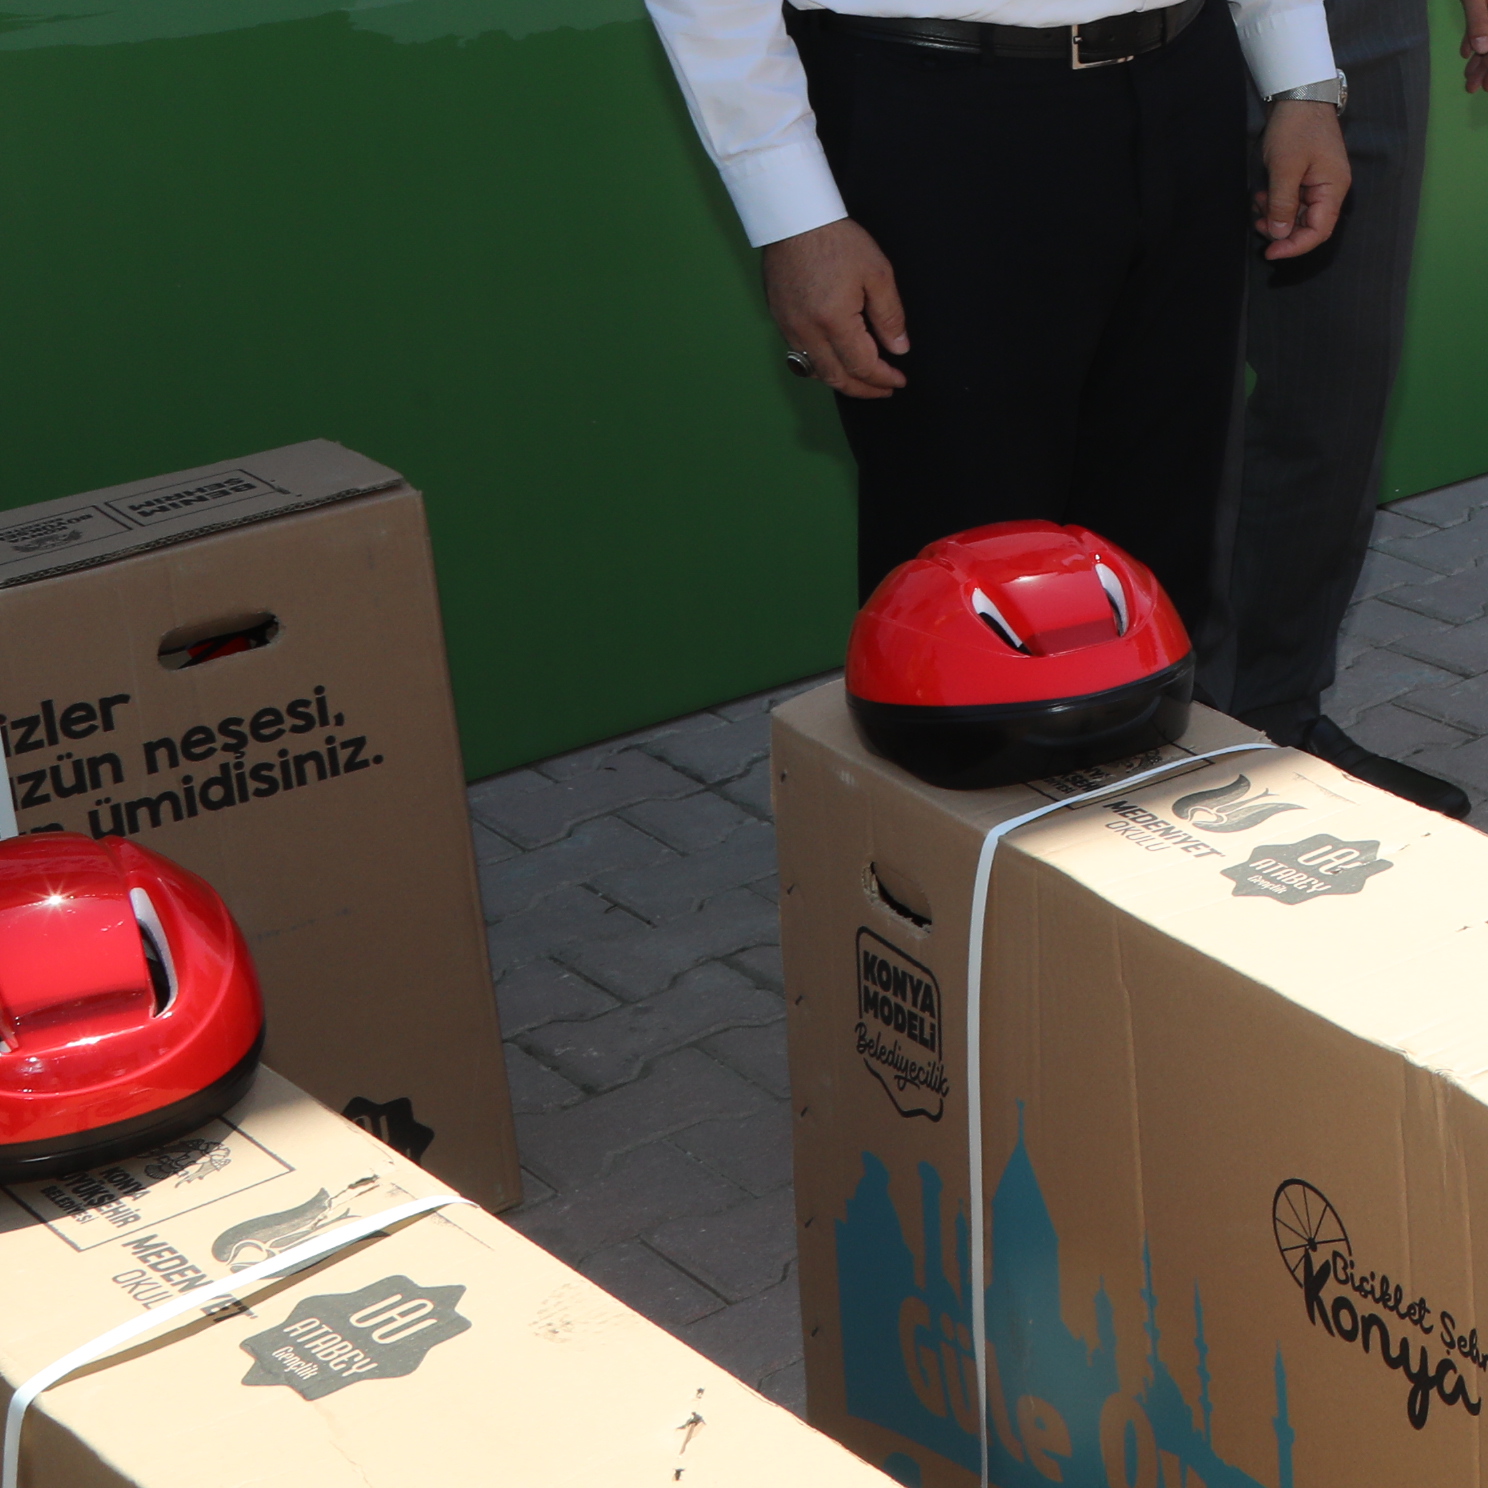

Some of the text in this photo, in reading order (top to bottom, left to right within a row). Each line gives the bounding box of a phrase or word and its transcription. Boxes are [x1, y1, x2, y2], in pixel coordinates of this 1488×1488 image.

[9, 684, 345, 811] zün neşesi,
[87, 734, 385, 841] ümidisiniz.
[1105, 820, 1172, 852] OKULU
[1249, 857, 1332, 896] ATABEY
[863, 949, 936, 1019] KONYA
[854, 1021, 950, 1098] Belediyecilik
[101, 1166, 152, 1202] KONYA
[112, 1269, 174, 1310] OKUL
[1331, 1249, 1434, 1335] Bisiklet
[283, 1316, 379, 1378] ATABEY
[1303, 1245, 1482, 1431] Konya
[898, 1295, 1073, 1483] Güle
